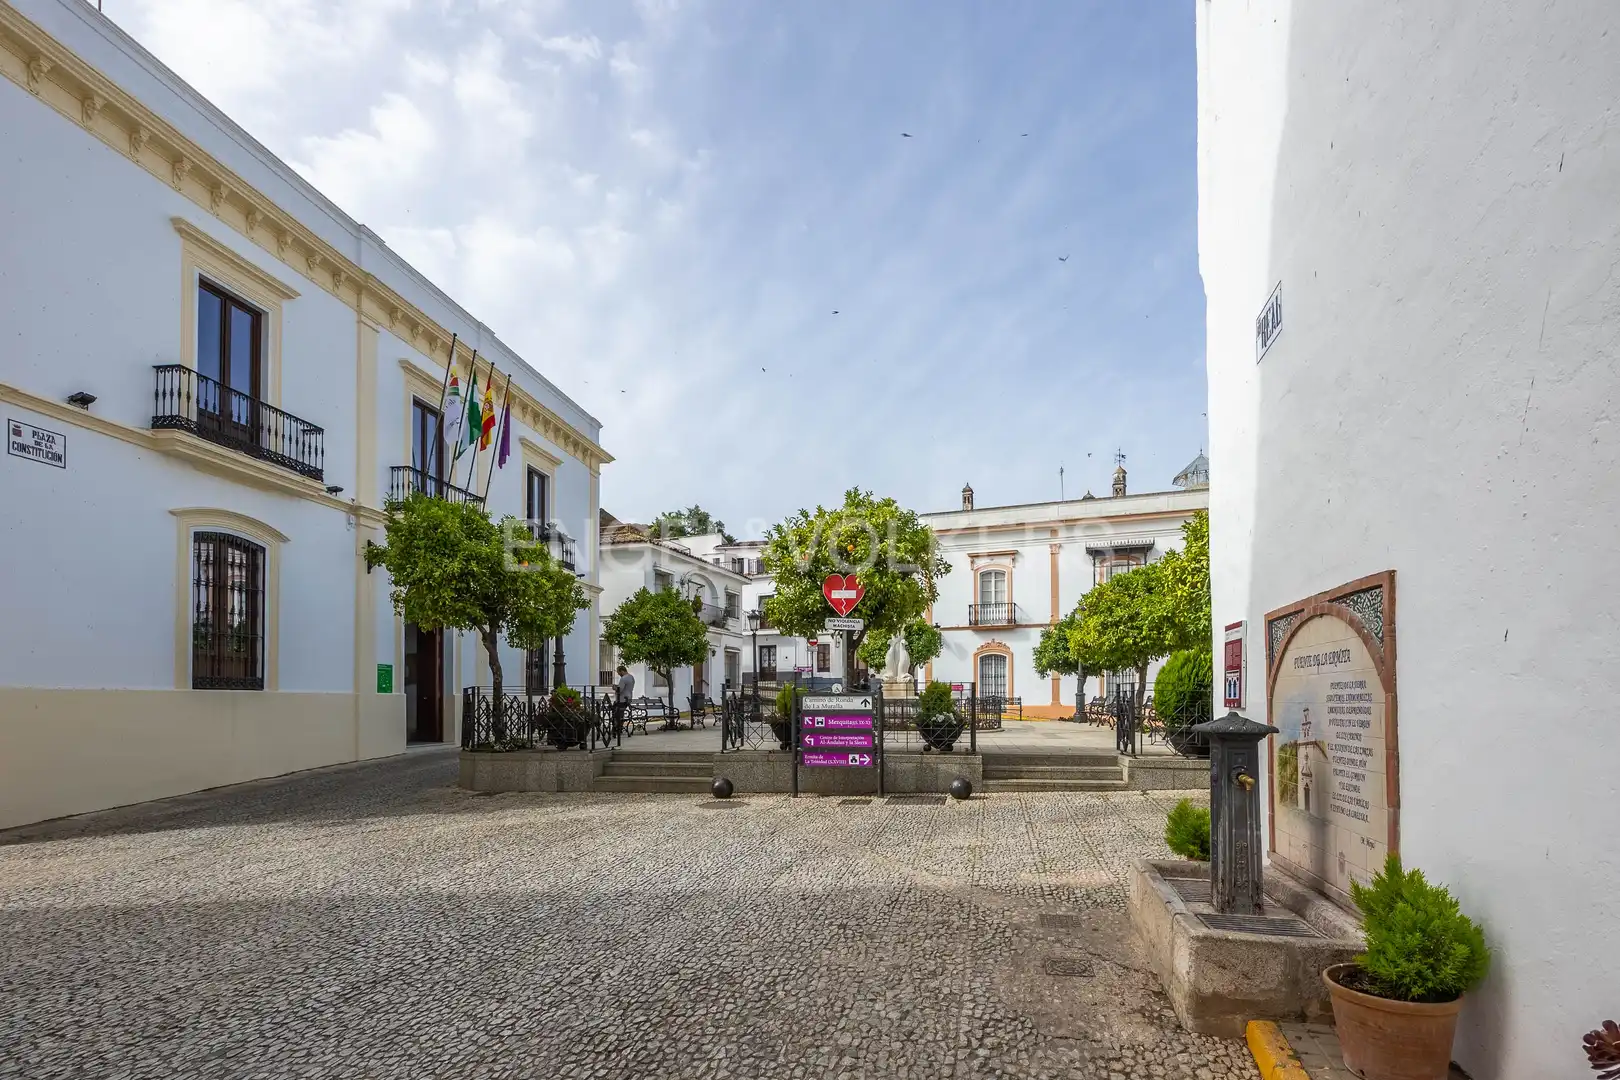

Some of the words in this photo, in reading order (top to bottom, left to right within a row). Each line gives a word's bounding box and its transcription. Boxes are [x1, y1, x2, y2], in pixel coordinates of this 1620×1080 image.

[1261, 295, 1282, 349] REAL
[32, 430, 56, 445] PLAZA
[12, 440, 63, 463] CONSTITUCIÓN
